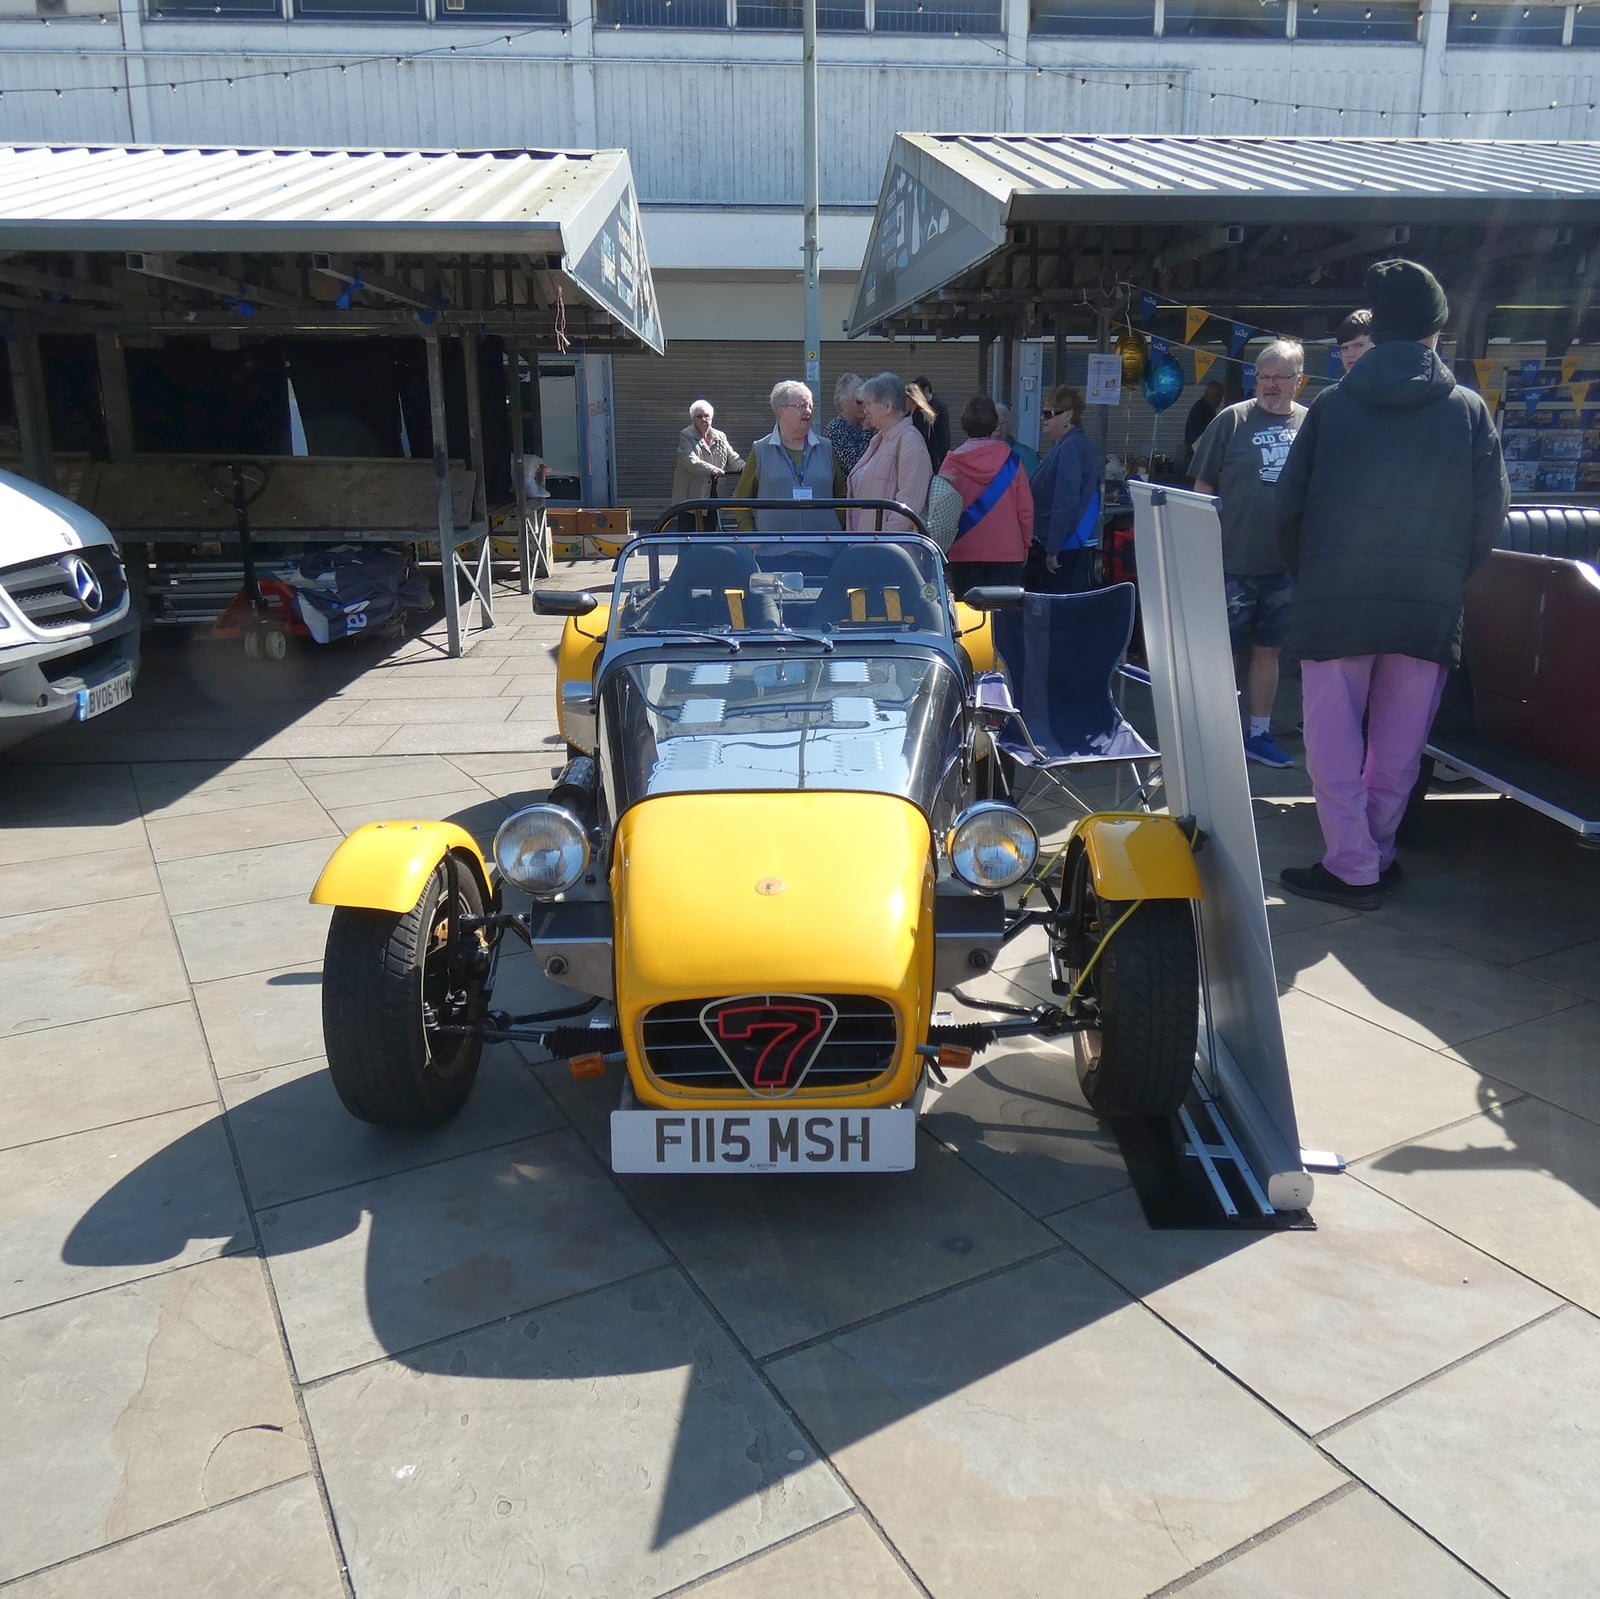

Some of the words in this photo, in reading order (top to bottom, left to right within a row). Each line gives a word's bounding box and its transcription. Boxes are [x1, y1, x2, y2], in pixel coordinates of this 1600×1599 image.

[809, 351, 816, 359] 2
[1252, 434, 1276, 445] OLD
[718, 1005, 822, 1086] 7
[768, 1117, 870, 1163] MSH
